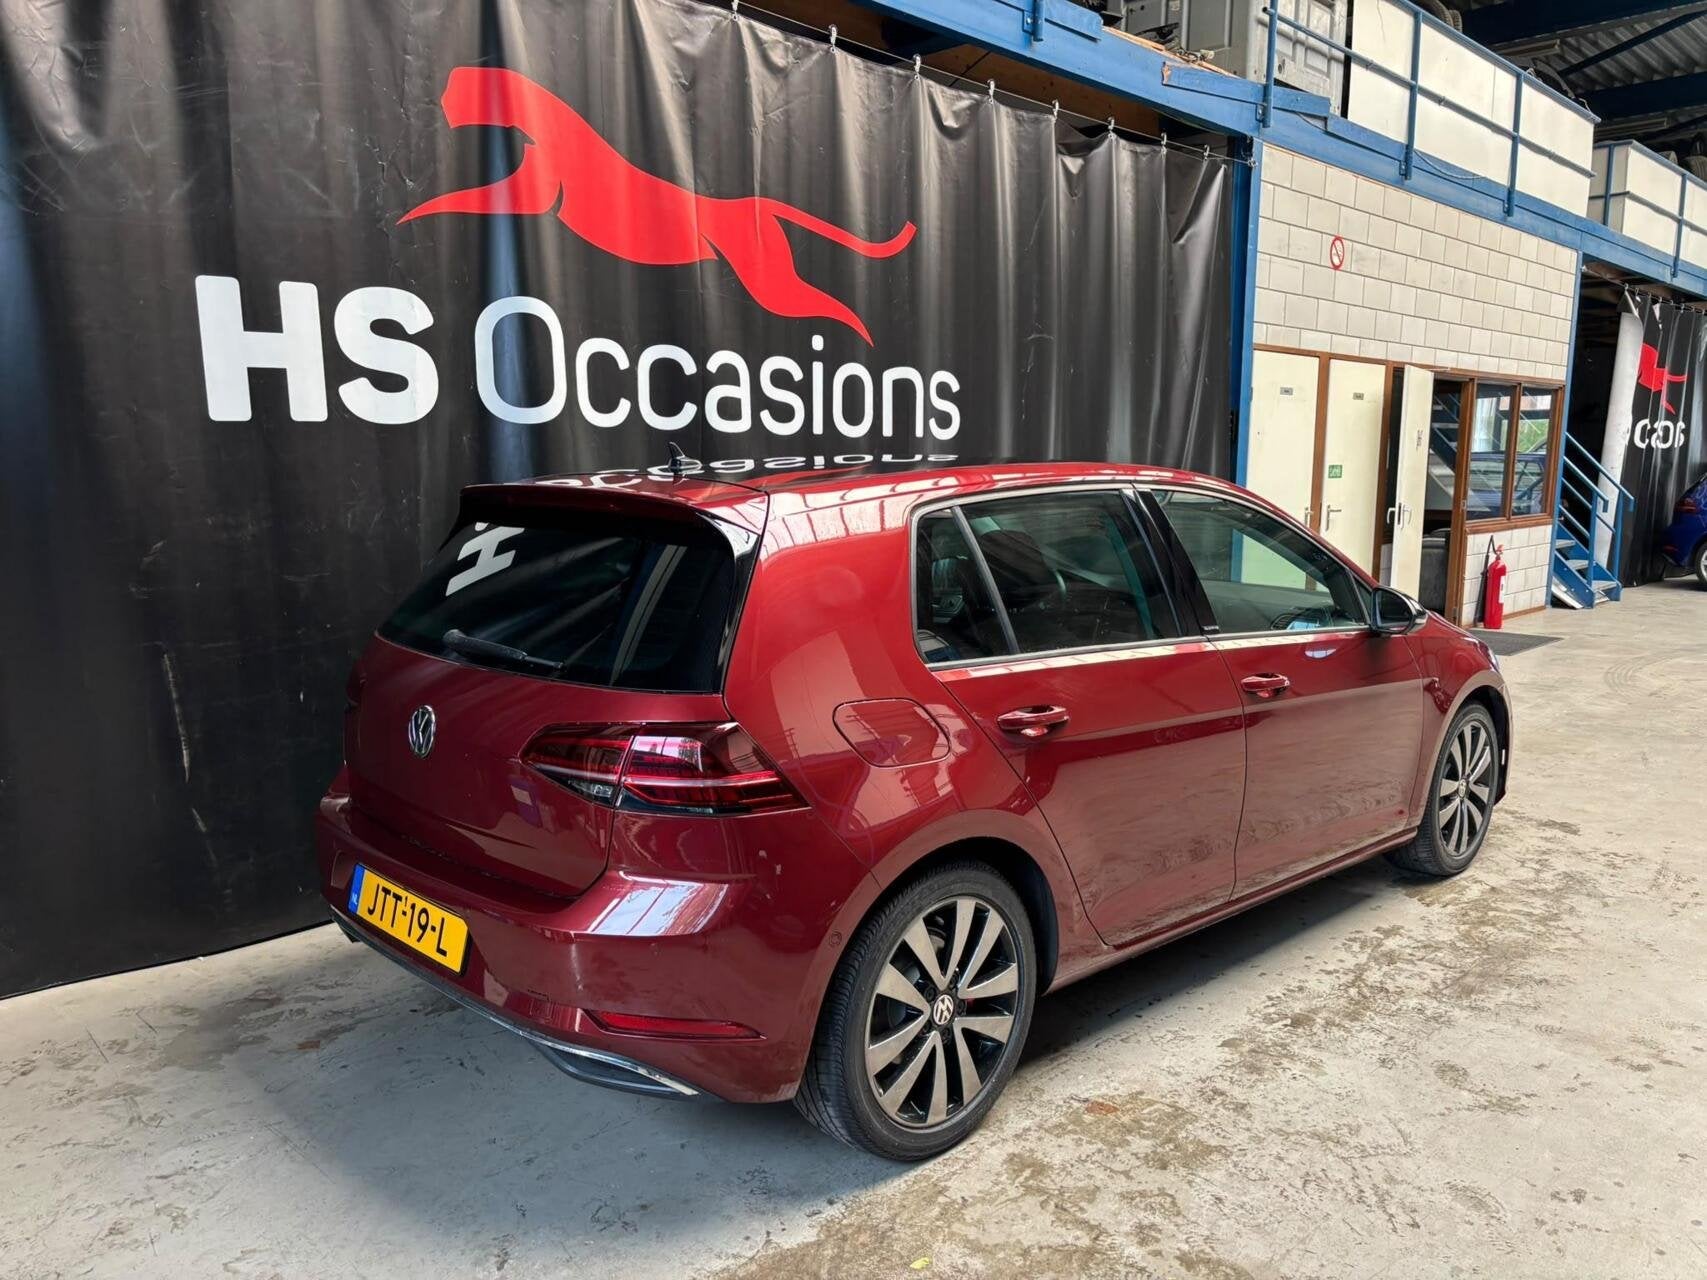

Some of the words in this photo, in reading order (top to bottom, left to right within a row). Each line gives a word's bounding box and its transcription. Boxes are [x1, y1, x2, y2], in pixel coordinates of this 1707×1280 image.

[195, 274, 439, 424] HS
[475, 296, 961, 440] Occasions
[367, 883, 448, 957] JTT-19-L
